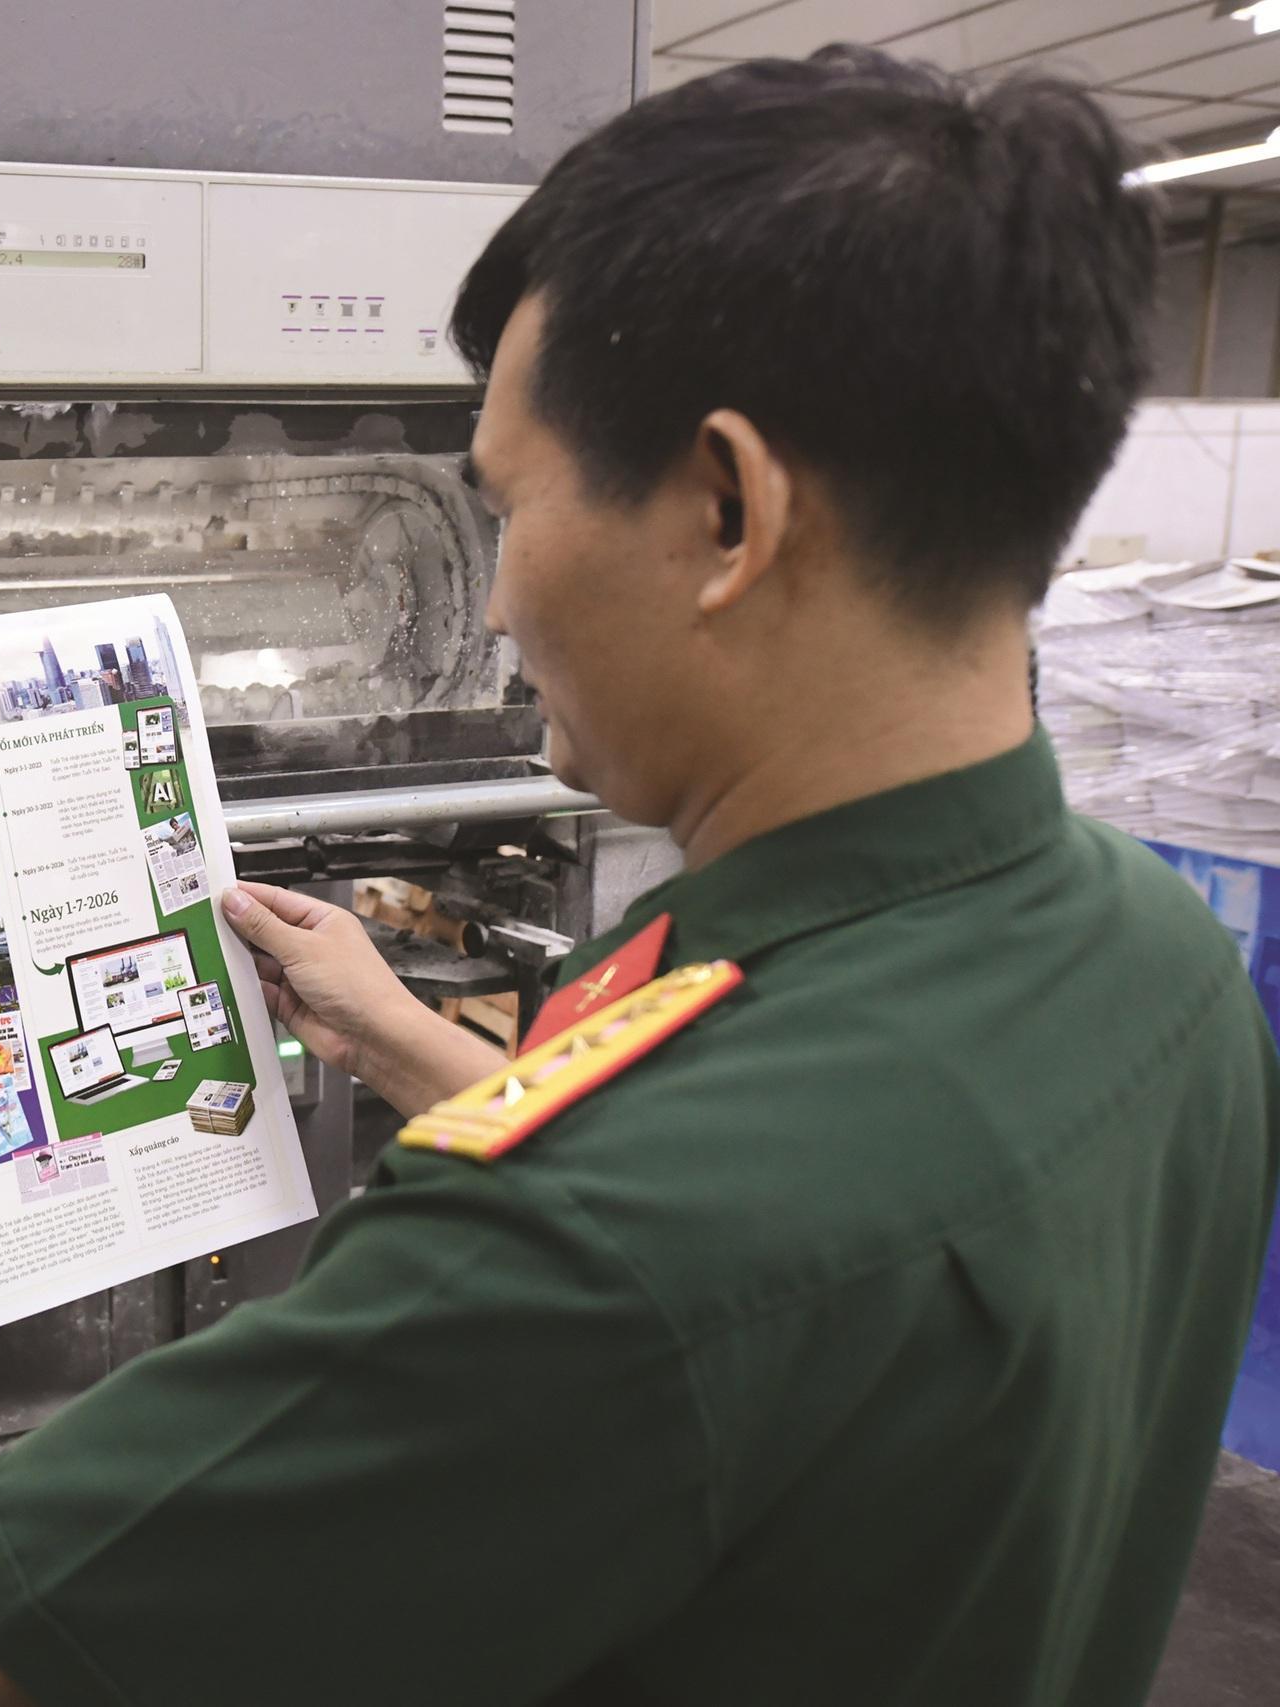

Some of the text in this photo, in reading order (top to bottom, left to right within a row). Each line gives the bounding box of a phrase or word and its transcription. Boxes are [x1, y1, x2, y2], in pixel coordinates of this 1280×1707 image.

[11, 735, 33, 749] MỚI
[32, 731, 48, 745] VÀ
[48, 727, 77, 742] PHÁT
[75, 720, 105, 737] TRIỂN
[3, 766, 19, 775] Ngày
[154, 782, 173, 802] AI
[10, 808, 26, 816] Ngày
[21, 867, 37, 876] Ngày
[29, 889, 119, 924] Ngày 1-7-2026
[128, 1135, 180, 1157] Xấp quảng cáo
